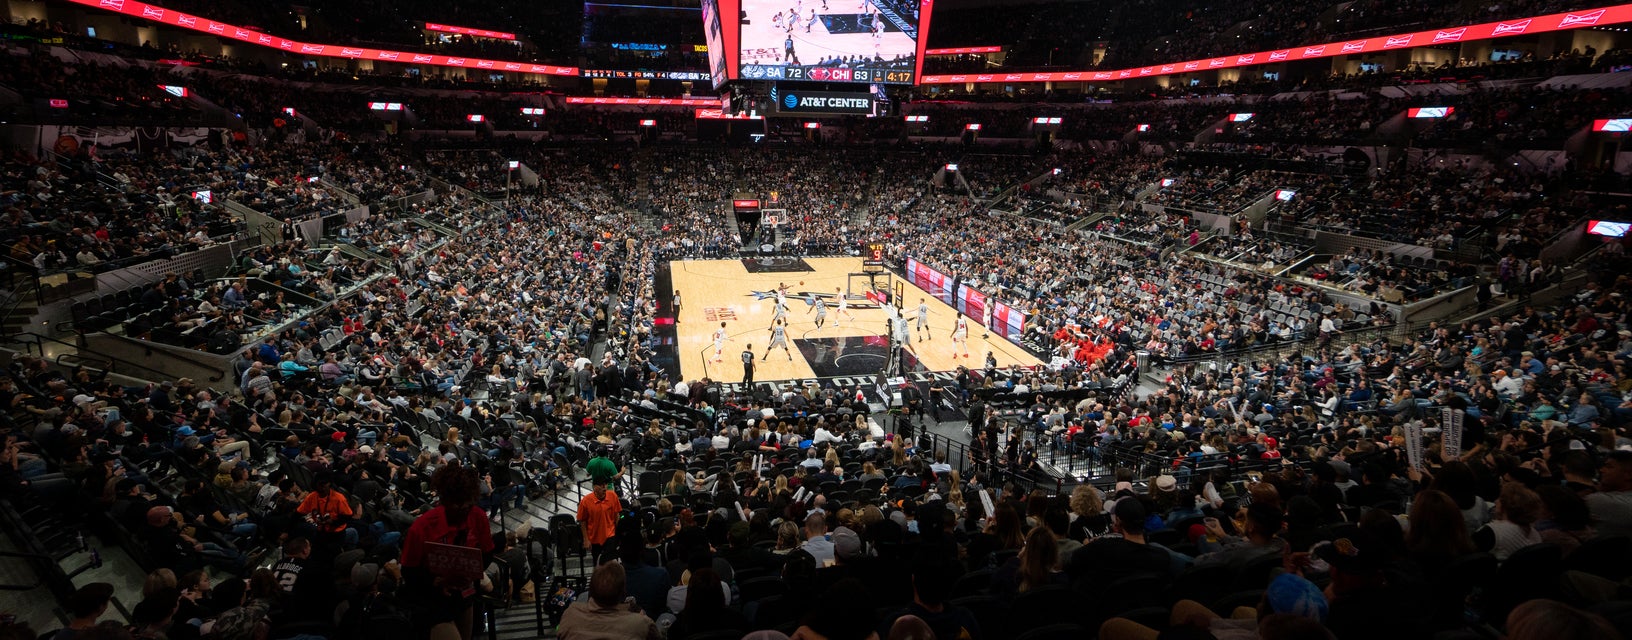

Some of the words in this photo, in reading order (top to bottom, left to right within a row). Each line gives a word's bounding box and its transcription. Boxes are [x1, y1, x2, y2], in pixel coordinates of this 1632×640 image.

[766, 68, 781, 77] SA
[787, 68, 801, 78] 72
[832, 69, 850, 80] CHI
[854, 70, 868, 80] 63
[887, 72, 911, 82] 4:17
[800, 97, 826, 107] AT&T
[827, 97, 869, 108] CENTER
[873, 250, 881, 260] 9
